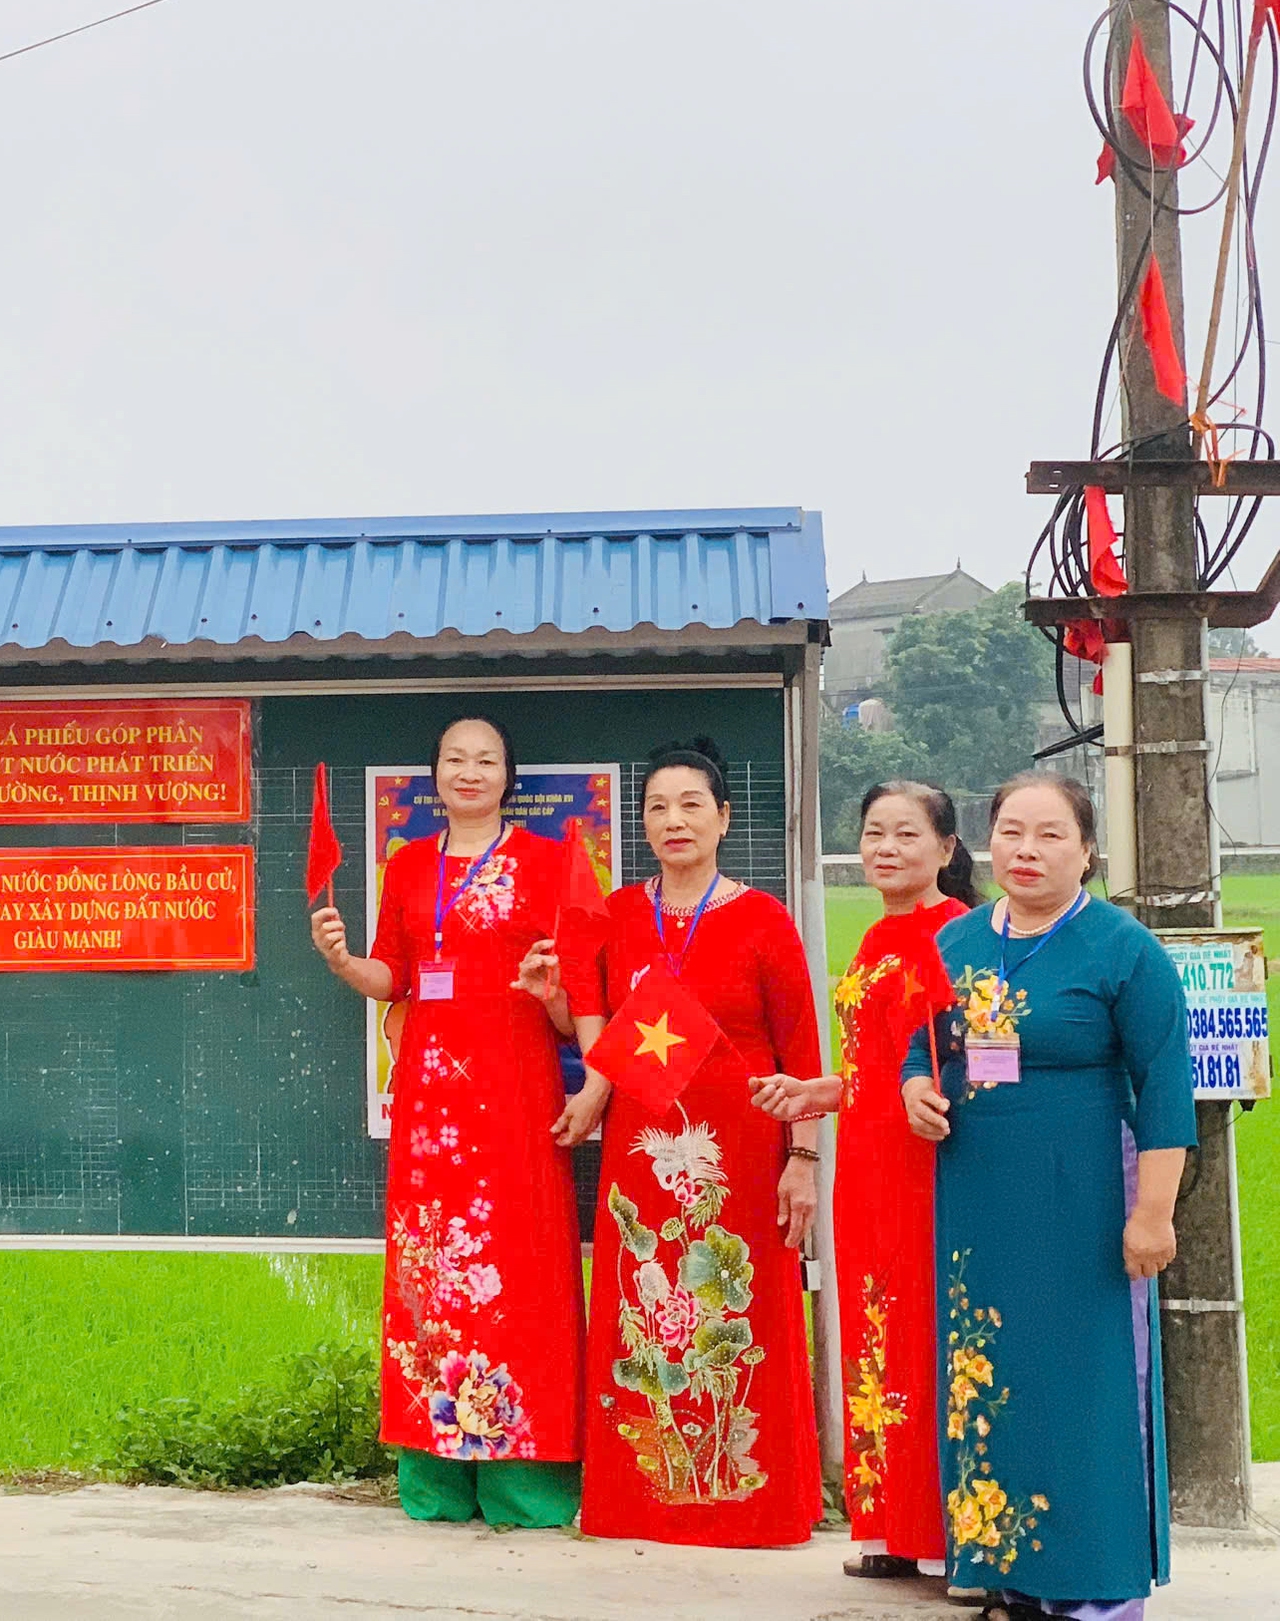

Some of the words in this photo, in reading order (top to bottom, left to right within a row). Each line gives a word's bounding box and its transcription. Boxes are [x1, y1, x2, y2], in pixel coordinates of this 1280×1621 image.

[25, 719, 90, 746] PHIẾU
[95, 722, 141, 745] GÓP
[146, 717, 204, 744] PHẦN
[20, 752, 81, 774] NƯỚC
[86, 750, 144, 773] PHÁT
[150, 746, 214, 773] TRIỂN
[69, 784, 138, 806] THỊNH
[144, 780, 226, 806] VƯỢNG!
[1, 869, 52, 893] NƯỚC
[56, 865, 108, 892] ĐỒNG
[111, 868, 161, 891] LÒNG
[166, 863, 202, 891] BẦU
[206, 866, 237, 893] CỬ,
[29, 897, 66, 920] XÂY
[70, 899, 120, 925] DỰNG
[124, 892, 161, 919] ĐẤT
[165, 896, 217, 919] NƯỚC
[13, 926, 58, 949] GIÀU
[63, 929, 122, 953] MẠNH!
